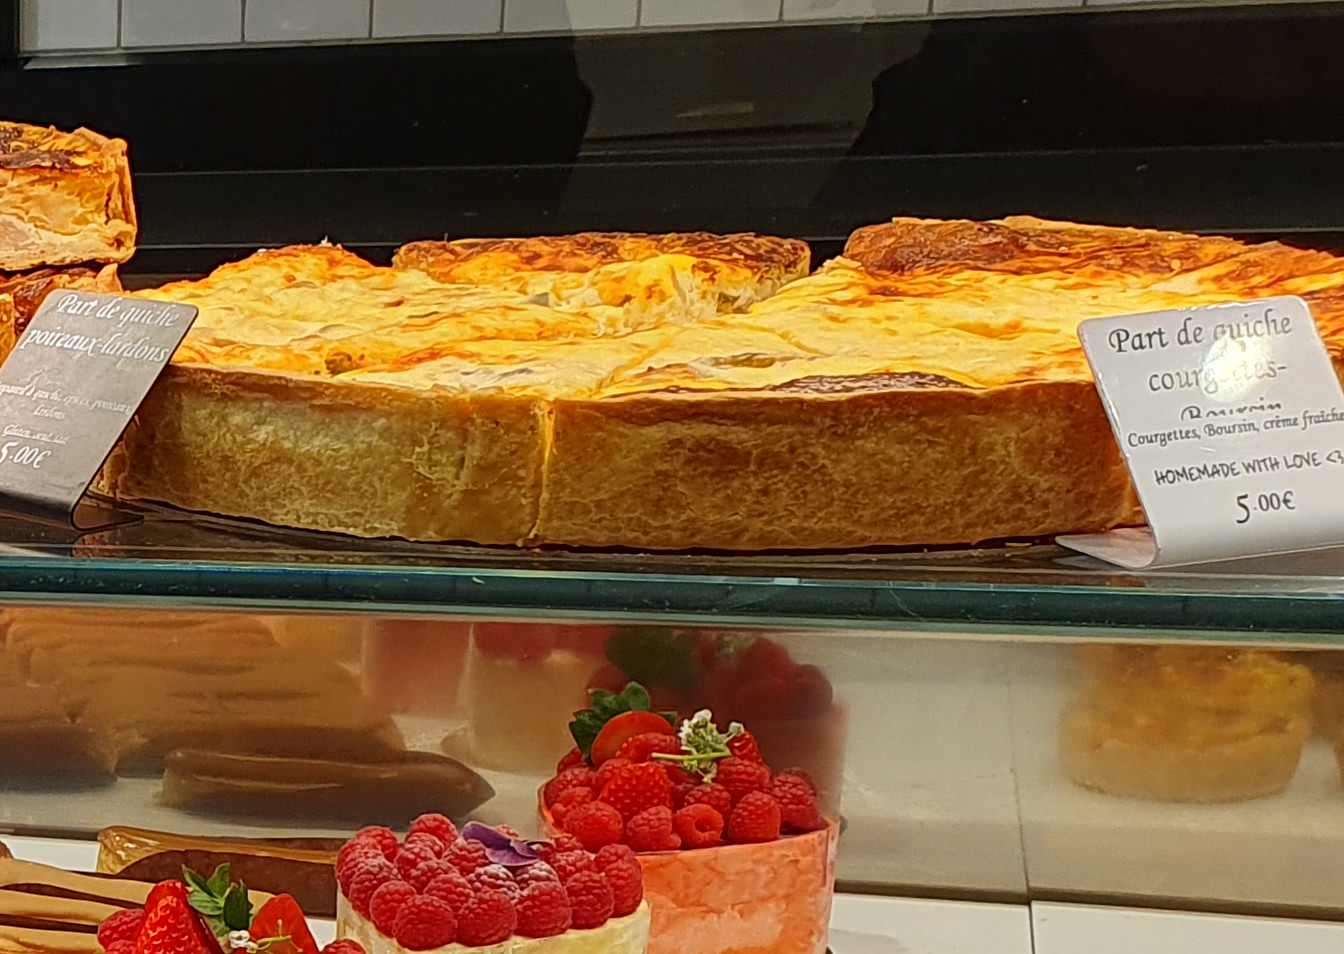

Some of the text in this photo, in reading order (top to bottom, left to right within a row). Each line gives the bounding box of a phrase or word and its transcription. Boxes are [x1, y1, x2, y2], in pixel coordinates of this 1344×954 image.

[55, 294, 180, 329] Part de quiche
[18, 326, 170, 363] poireaux-lardons
[1108, 327, 1169, 354] Part
[1177, 317, 1204, 346] de
[1127, 428, 1202, 448] Courgettes,
[1203, 418, 1260, 437] Boursin,
[1154, 461, 1241, 485] HOMEMADE
[1241, 455, 1281, 475] WITH
[1282, 451, 1323, 470] LOVE
[1235, 490, 1297, 524] 5.00€
